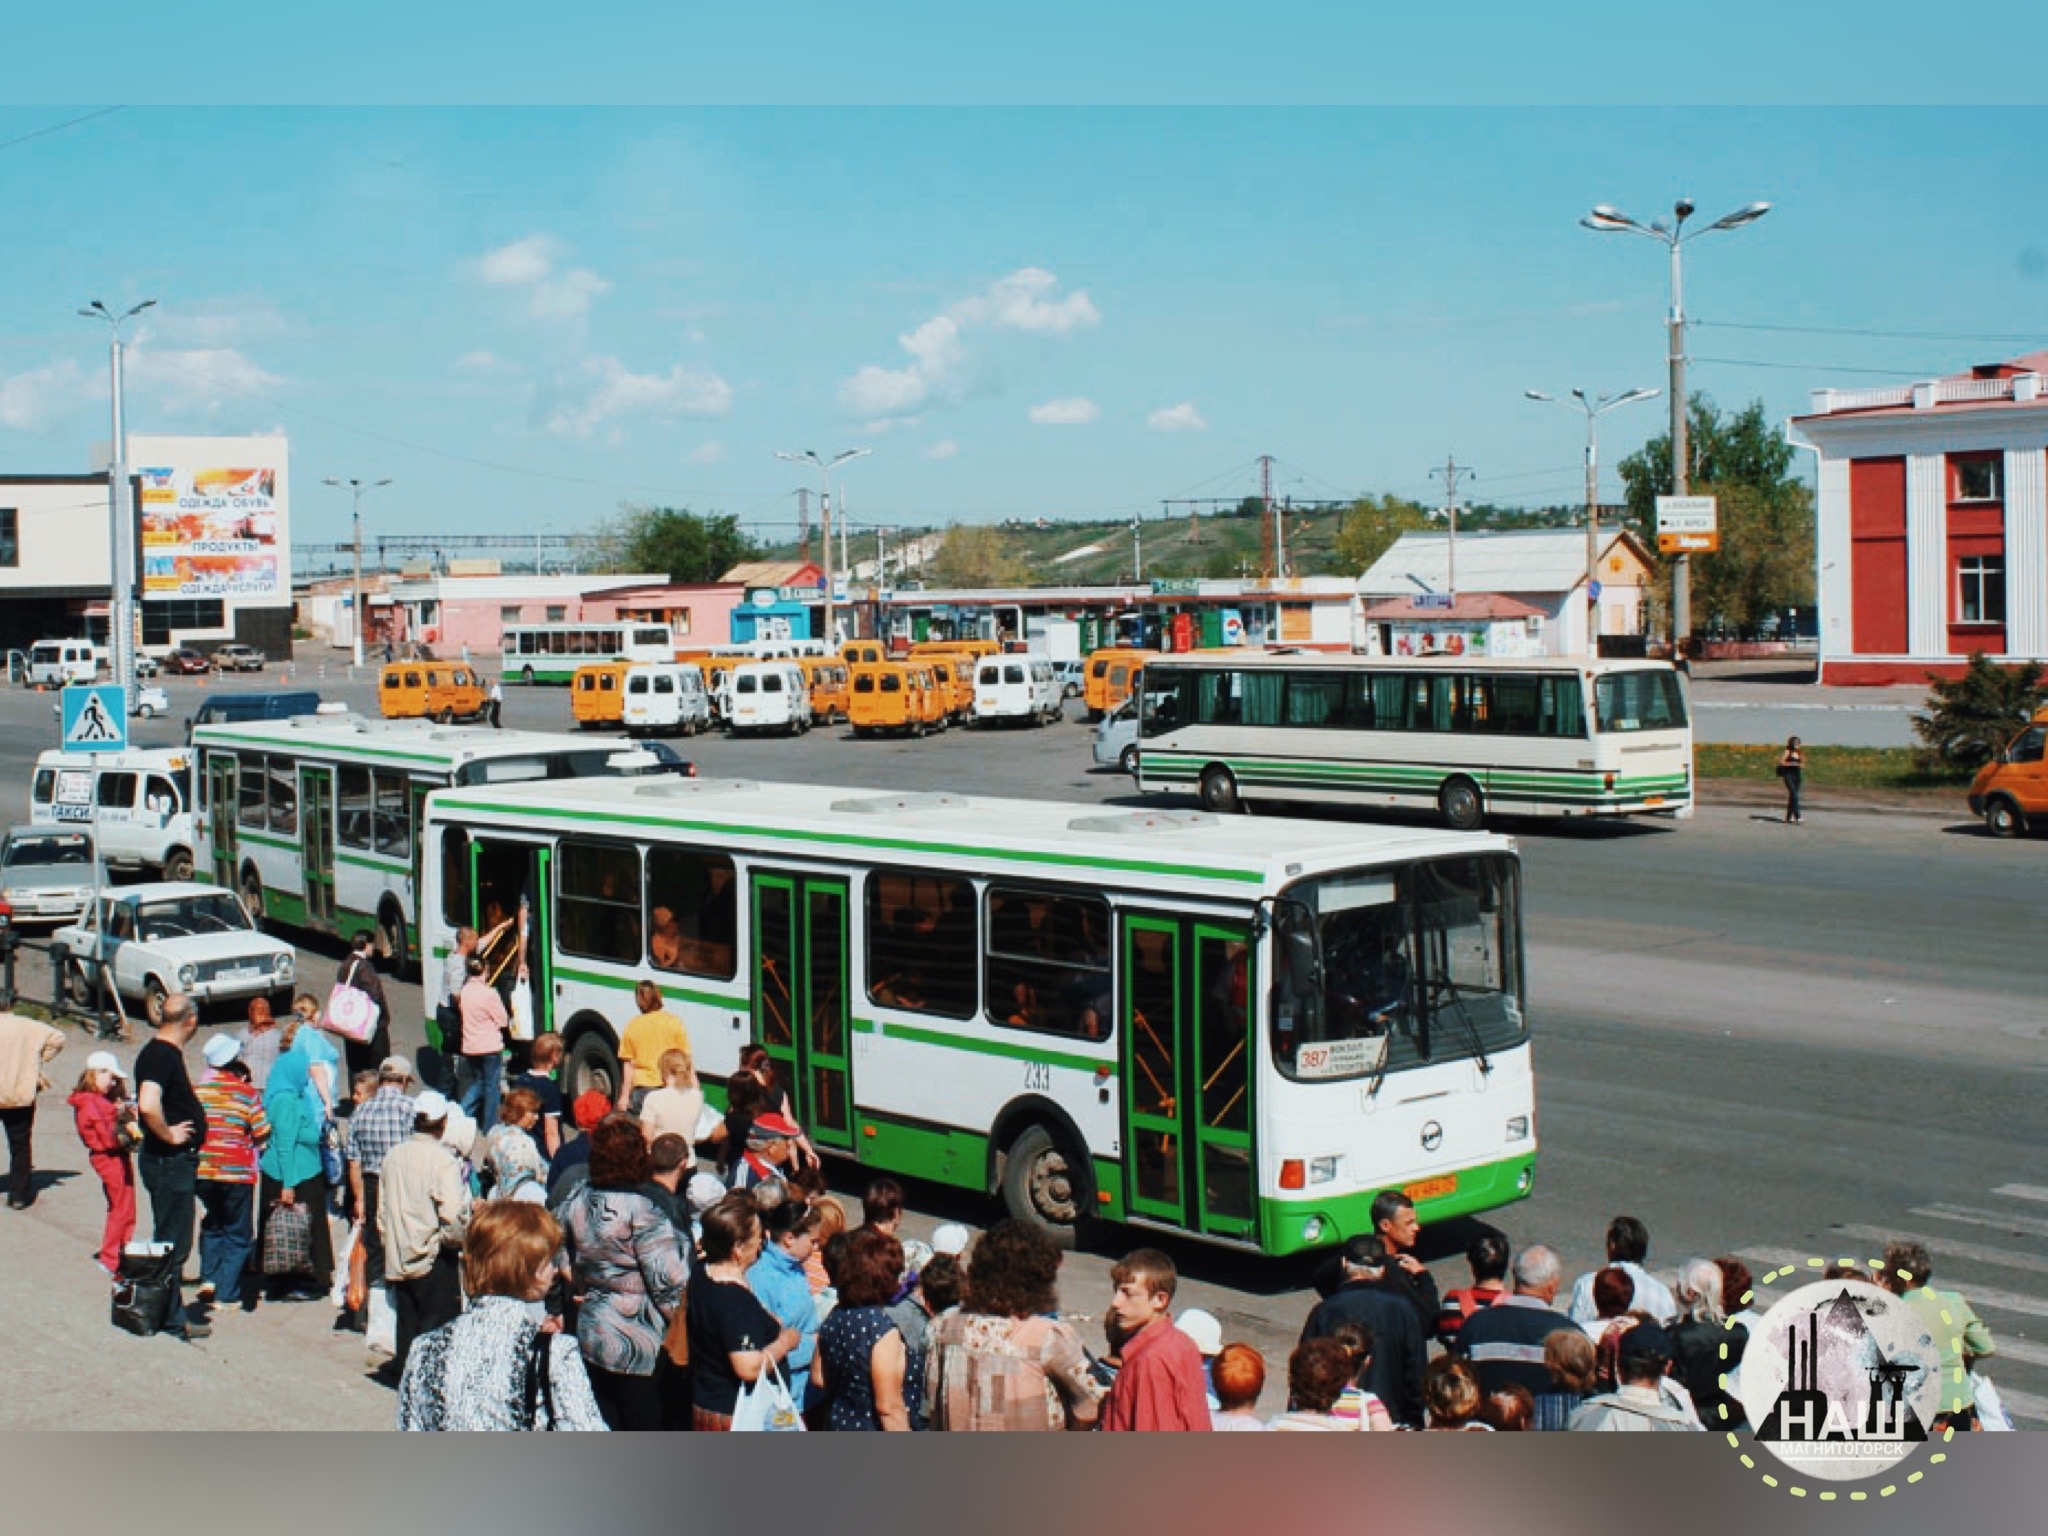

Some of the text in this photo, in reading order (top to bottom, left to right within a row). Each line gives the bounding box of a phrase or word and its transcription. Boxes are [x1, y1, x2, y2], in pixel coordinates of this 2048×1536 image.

[179, 498, 269, 508] ОДЕЖДА ОБУВЬ
[192, 542, 258, 552] ПРОДУКТЫ
[1300, 1050, 1328, 1069] 387
[1024, 1061, 1050, 1091] 233
